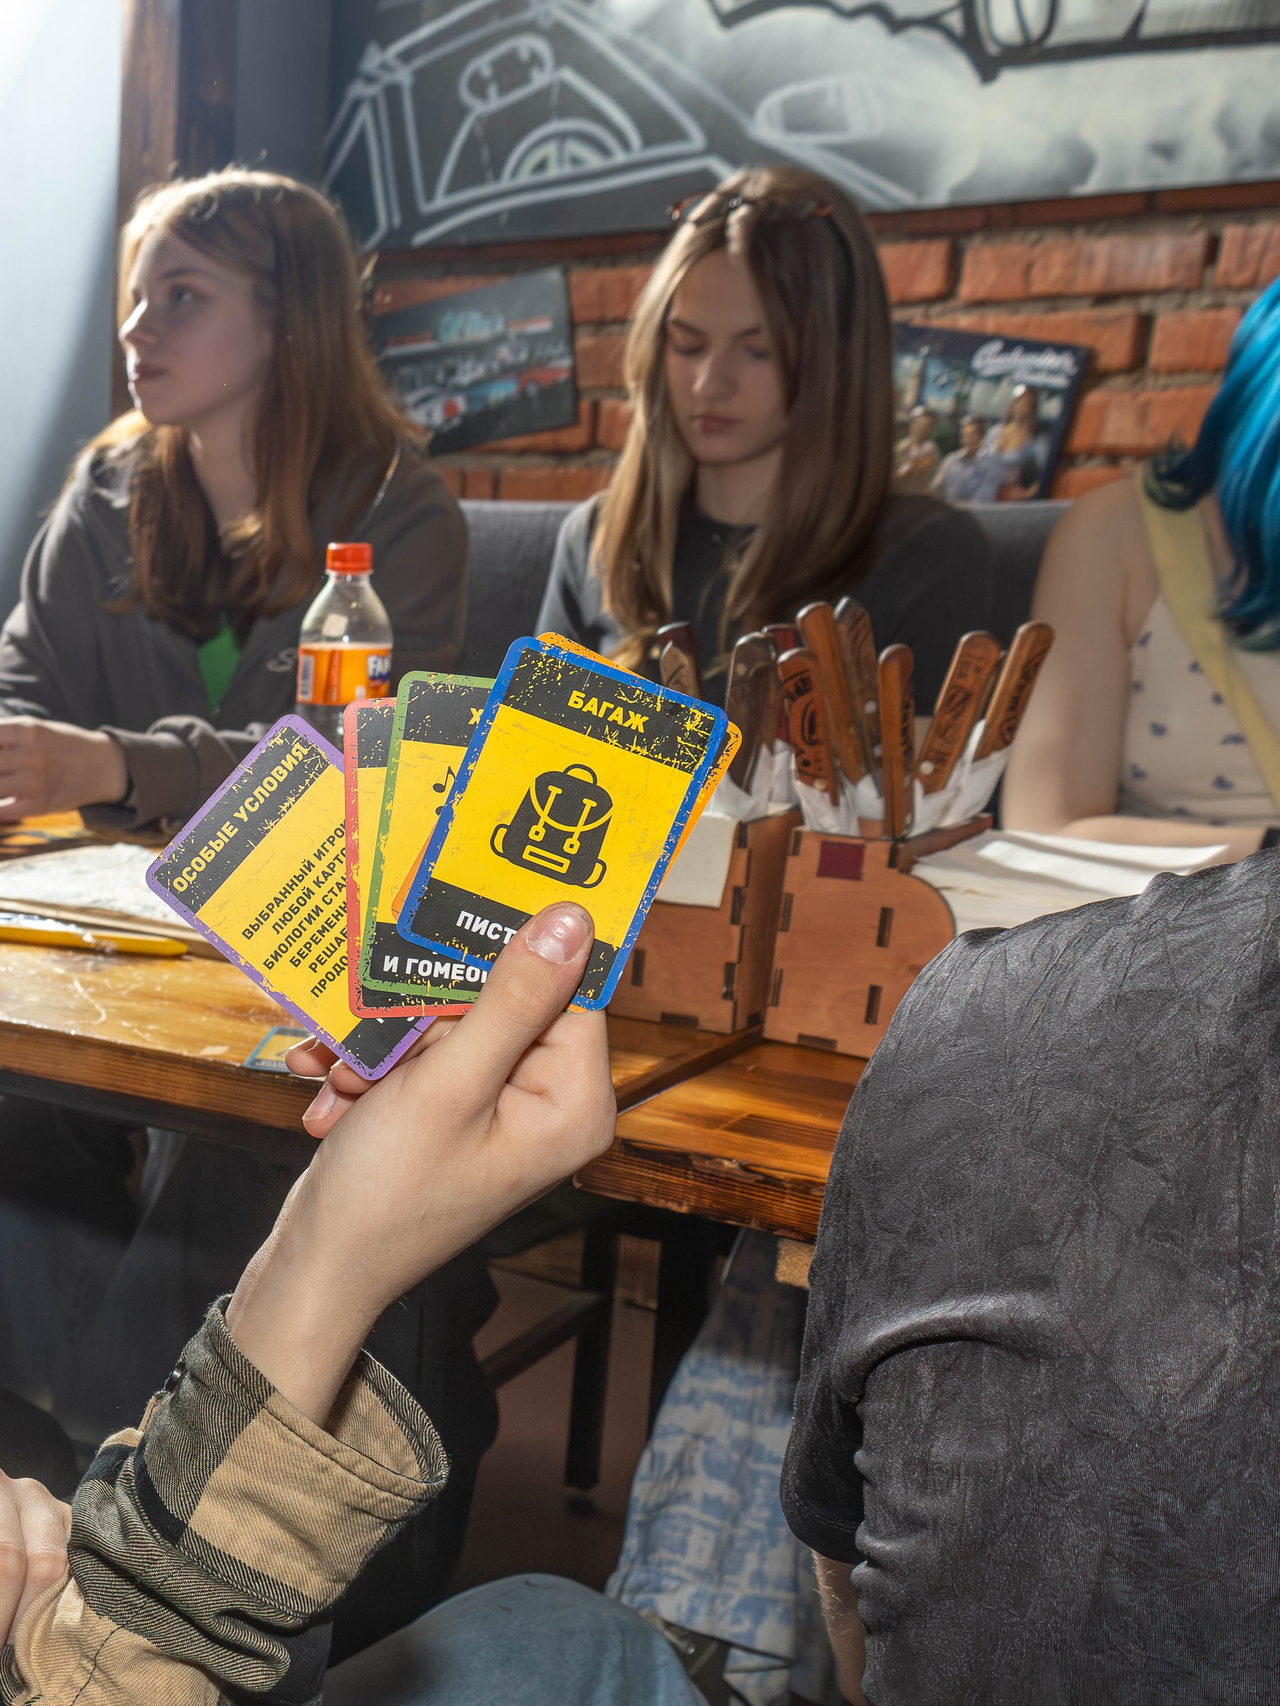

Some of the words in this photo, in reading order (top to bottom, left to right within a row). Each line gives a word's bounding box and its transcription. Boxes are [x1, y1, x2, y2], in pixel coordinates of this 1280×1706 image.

[568, 690, 649, 733] БАГАЖ
[173, 820, 239, 892] ОСОБЫЕ
[233, 743, 309, 822] УСЛОВИЯ
[241, 859, 316, 941] ВЫБРАННЫЙ
[271, 886, 316, 935] ЛЮБОЙ
[262, 905, 324, 971] БИОЛОГИИ
[308, 926, 348, 974] РЕШАЕ
[455, 910, 518, 945] ПИСТ
[310, 953, 348, 998] ПРОДО
[383, 955, 399, 973] И
